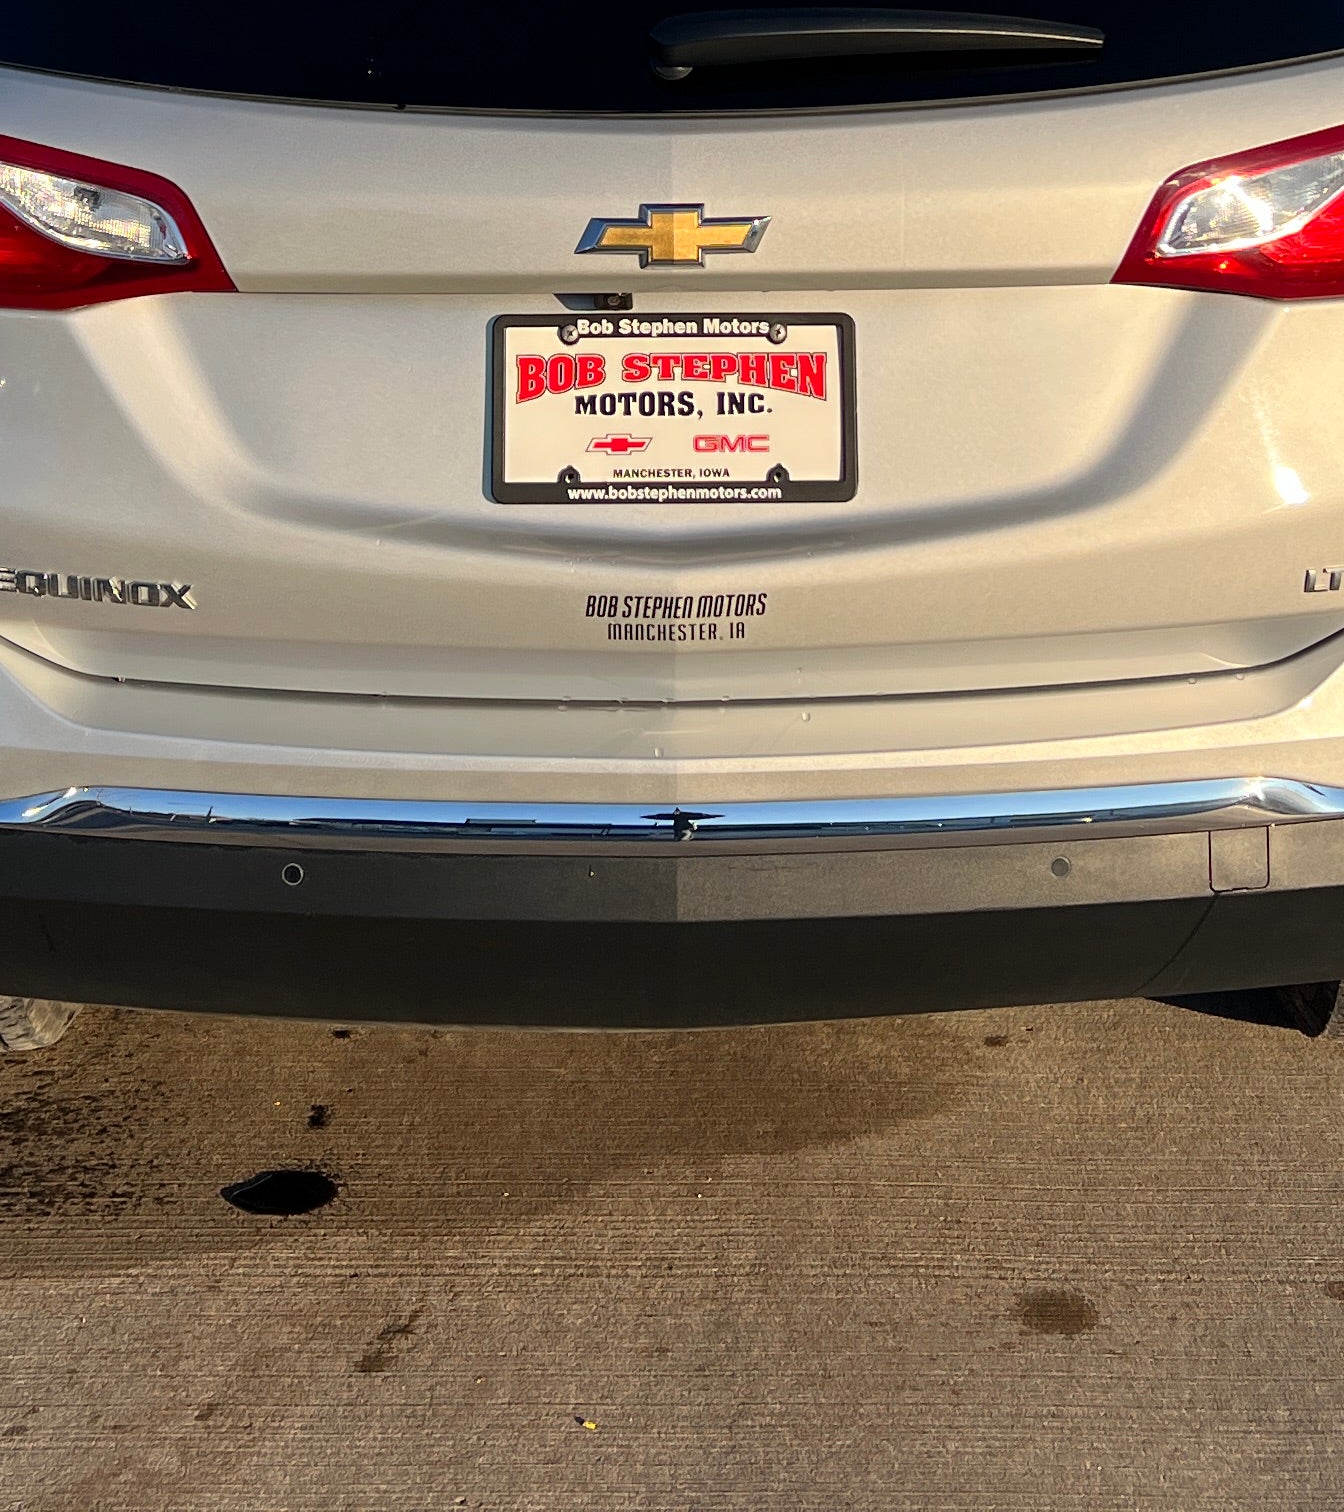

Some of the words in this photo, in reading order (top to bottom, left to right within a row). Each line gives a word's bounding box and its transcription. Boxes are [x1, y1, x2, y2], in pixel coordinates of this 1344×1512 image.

[577, 319, 614, 335] Bob
[618, 319, 698, 337] Stephen
[703, 318, 770, 335] Motors
[516, 353, 606, 404] BOB
[621, 352, 828, 401] STEPHEN
[574, 391, 704, 420] MOTORS,
[716, 391, 773, 415] INC.
[692, 434, 770, 453] GMC
[612, 468, 697, 481] MANCHESTER,
[699, 468, 731, 479] IOWA
[567, 486, 782, 503] www.bobstephenmotors.com
[585, 594, 619, 618] BOB
[622, 595, 695, 619] STEPHEN
[696, 592, 768, 619] MOTORS
[729, 621, 745, 639] IA
